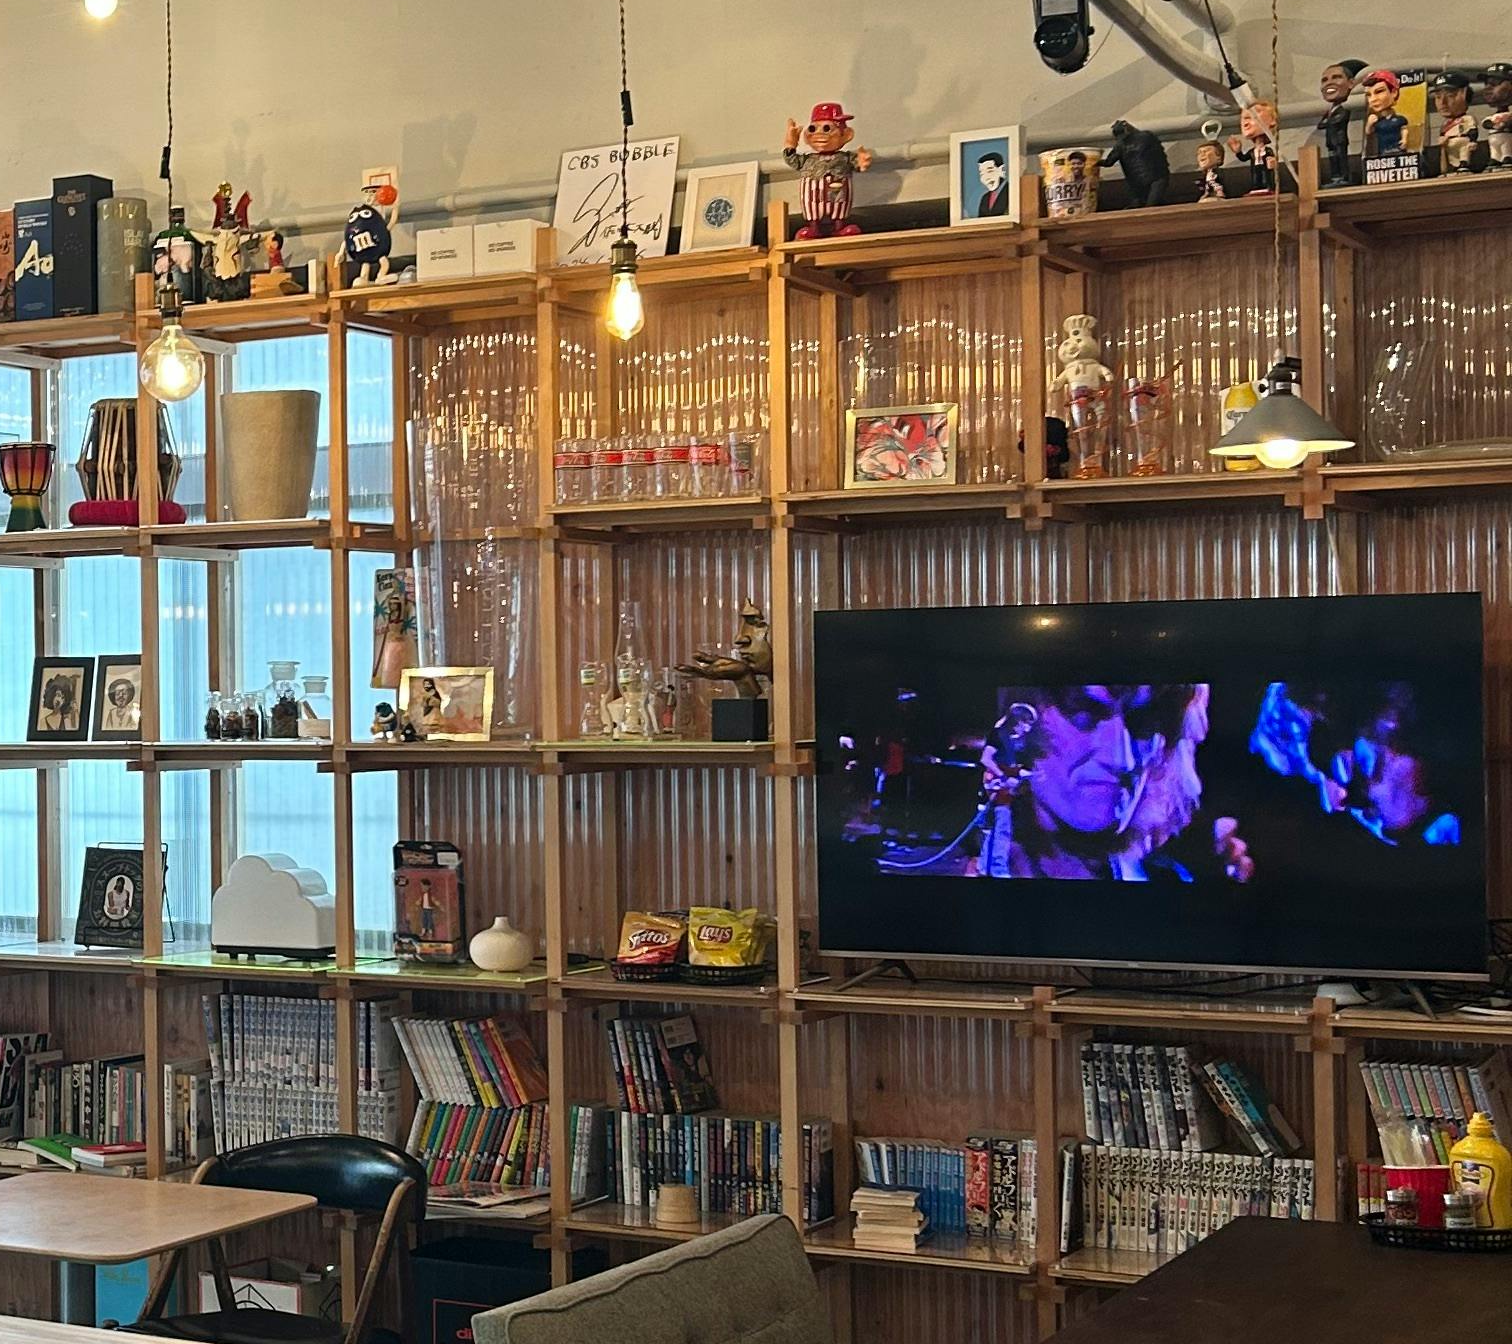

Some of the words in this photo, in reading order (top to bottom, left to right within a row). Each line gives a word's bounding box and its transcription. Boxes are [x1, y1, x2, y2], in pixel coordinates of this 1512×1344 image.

[567, 154, 600, 170] CBS
[609, 143, 676, 163] BUBBLE
[1366, 158, 1396, 170] ROSIE
[1399, 155, 1418, 166] THE
[1367, 167, 1419, 184] RIVETER
